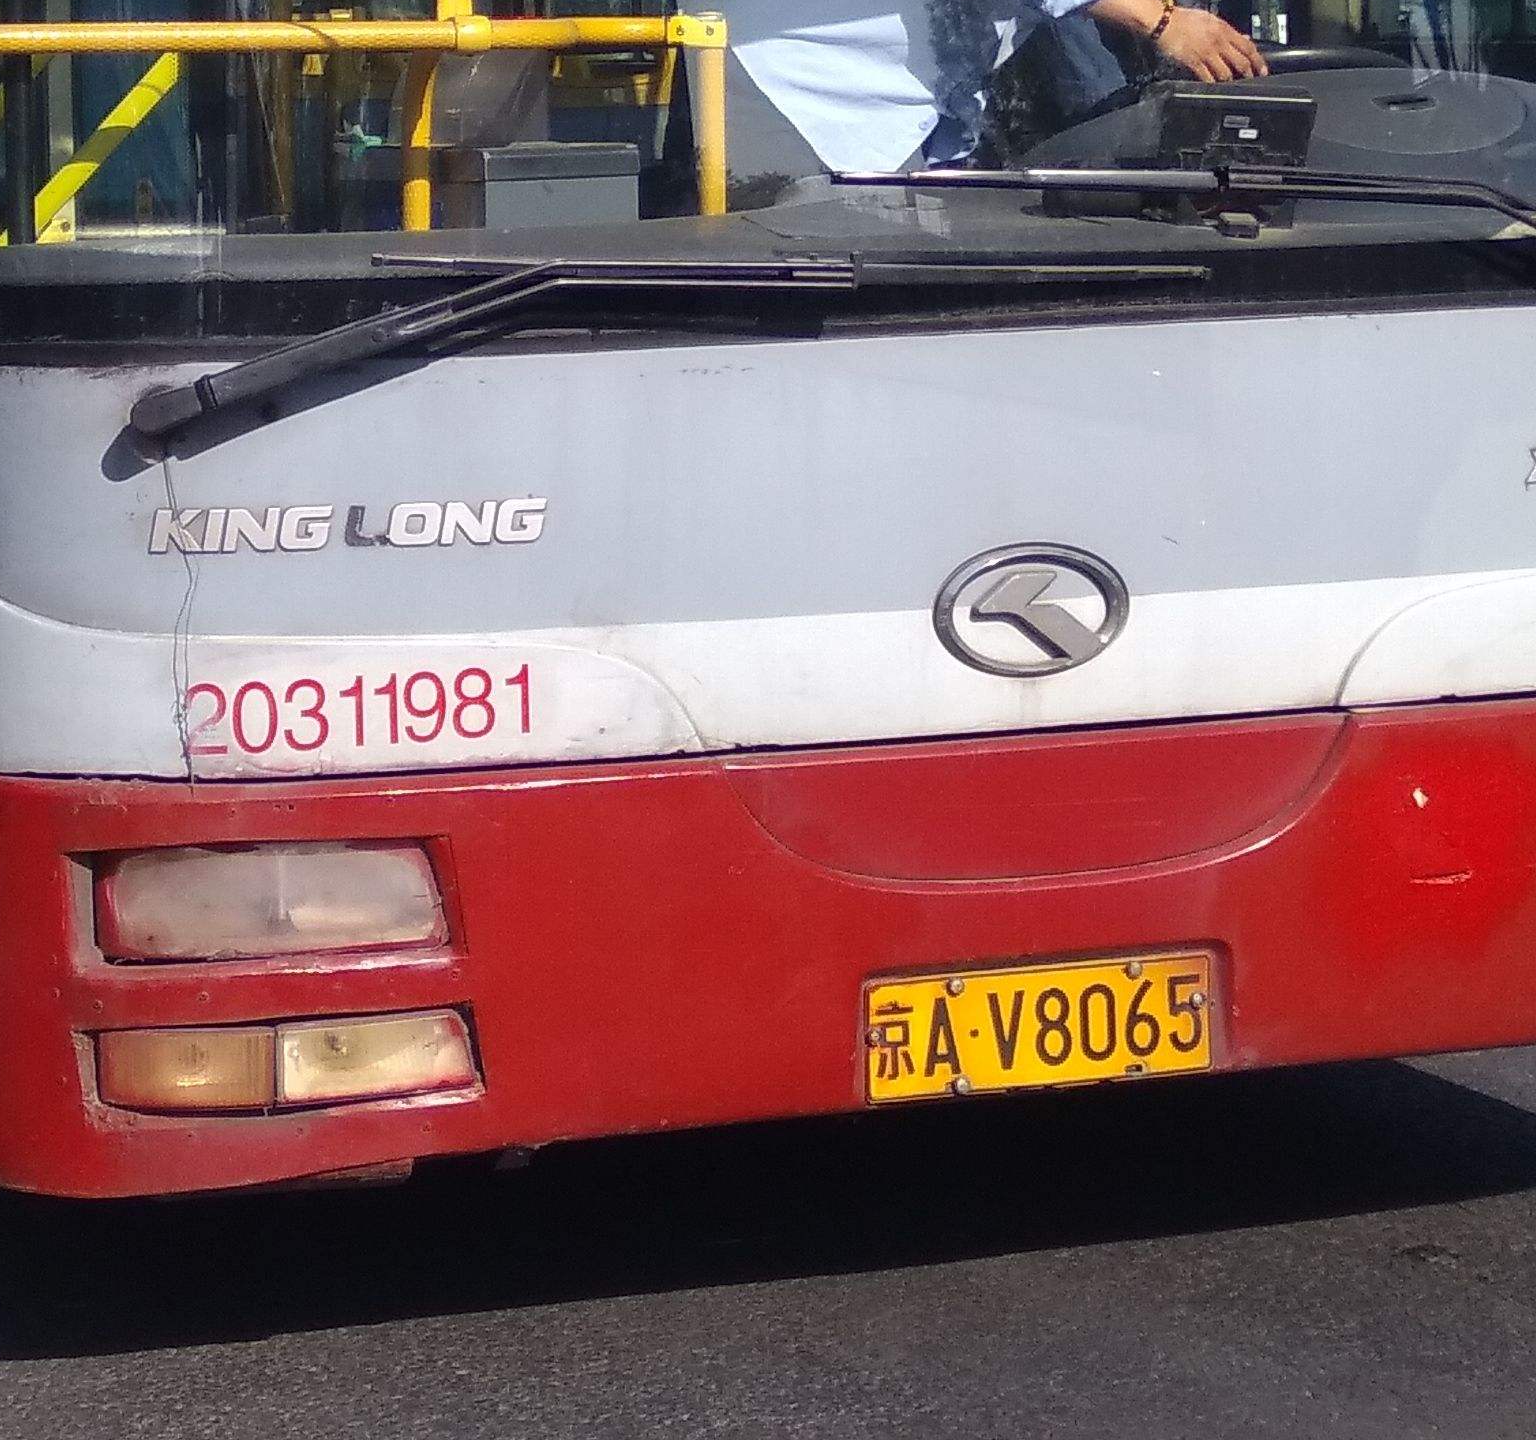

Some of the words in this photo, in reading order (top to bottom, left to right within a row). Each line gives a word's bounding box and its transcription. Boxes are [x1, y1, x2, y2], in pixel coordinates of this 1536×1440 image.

[148, 504, 333, 554] KING
[344, 497, 548, 547] LONG
[182, 663, 532, 755] 20311981
